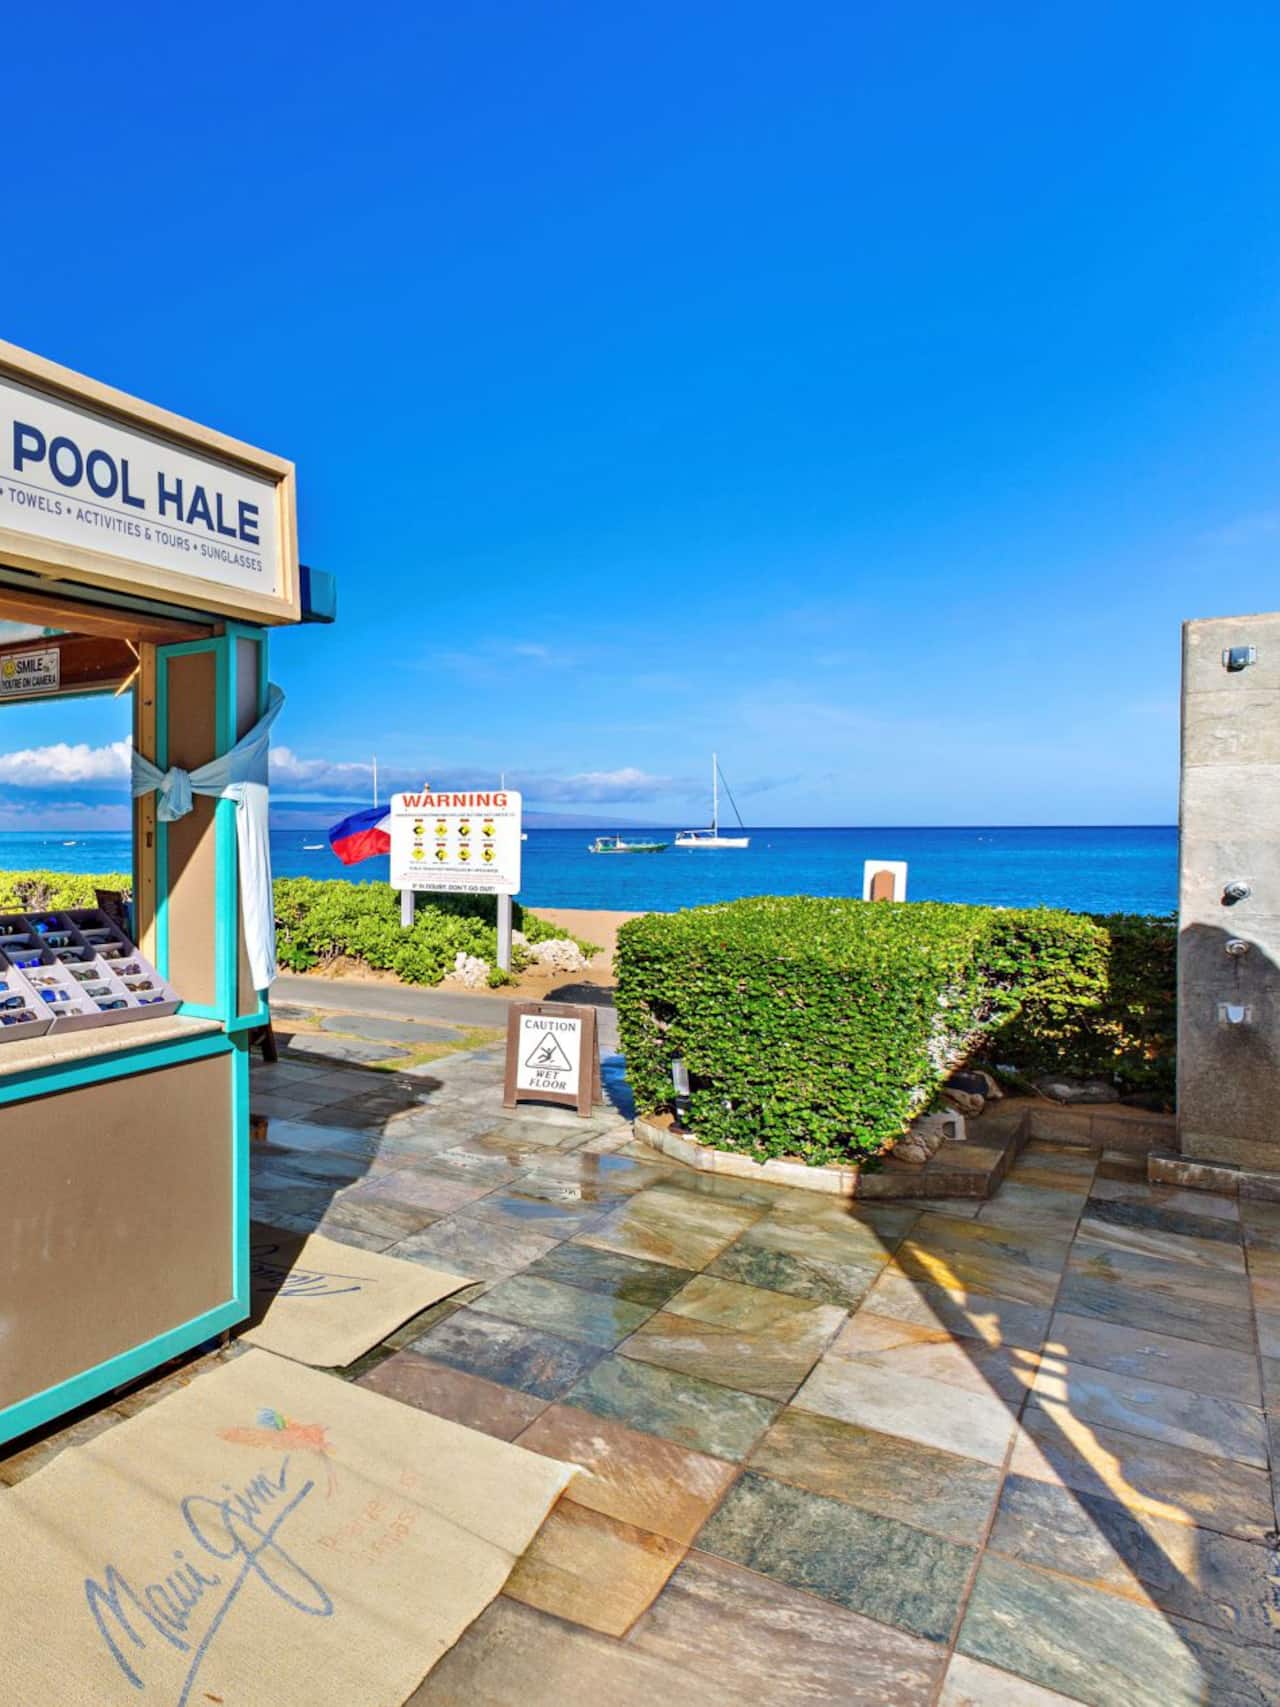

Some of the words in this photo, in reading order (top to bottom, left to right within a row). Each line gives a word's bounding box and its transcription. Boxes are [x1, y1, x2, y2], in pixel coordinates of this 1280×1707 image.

[13, 420, 146, 510] POOL
[158, 471, 261, 545] HALE
[9, 489, 63, 516] TOWELS
[76, 507, 142, 538] ACTIVITIES
[144, 527, 152, 541] &
[155, 529, 191, 552] TOURS
[200, 543, 263, 573] SUNGLASSES
[16, 657, 44, 673] SMILE
[32, 674, 56, 687] CAMERA
[402, 793, 508, 808] WARNING
[524, 1019, 577, 1032] CAUTION
[535, 1070, 560, 1080] WET
[528, 1078, 568, 1090] FLOOR
[82, 1548, 222, 1692] Maui
